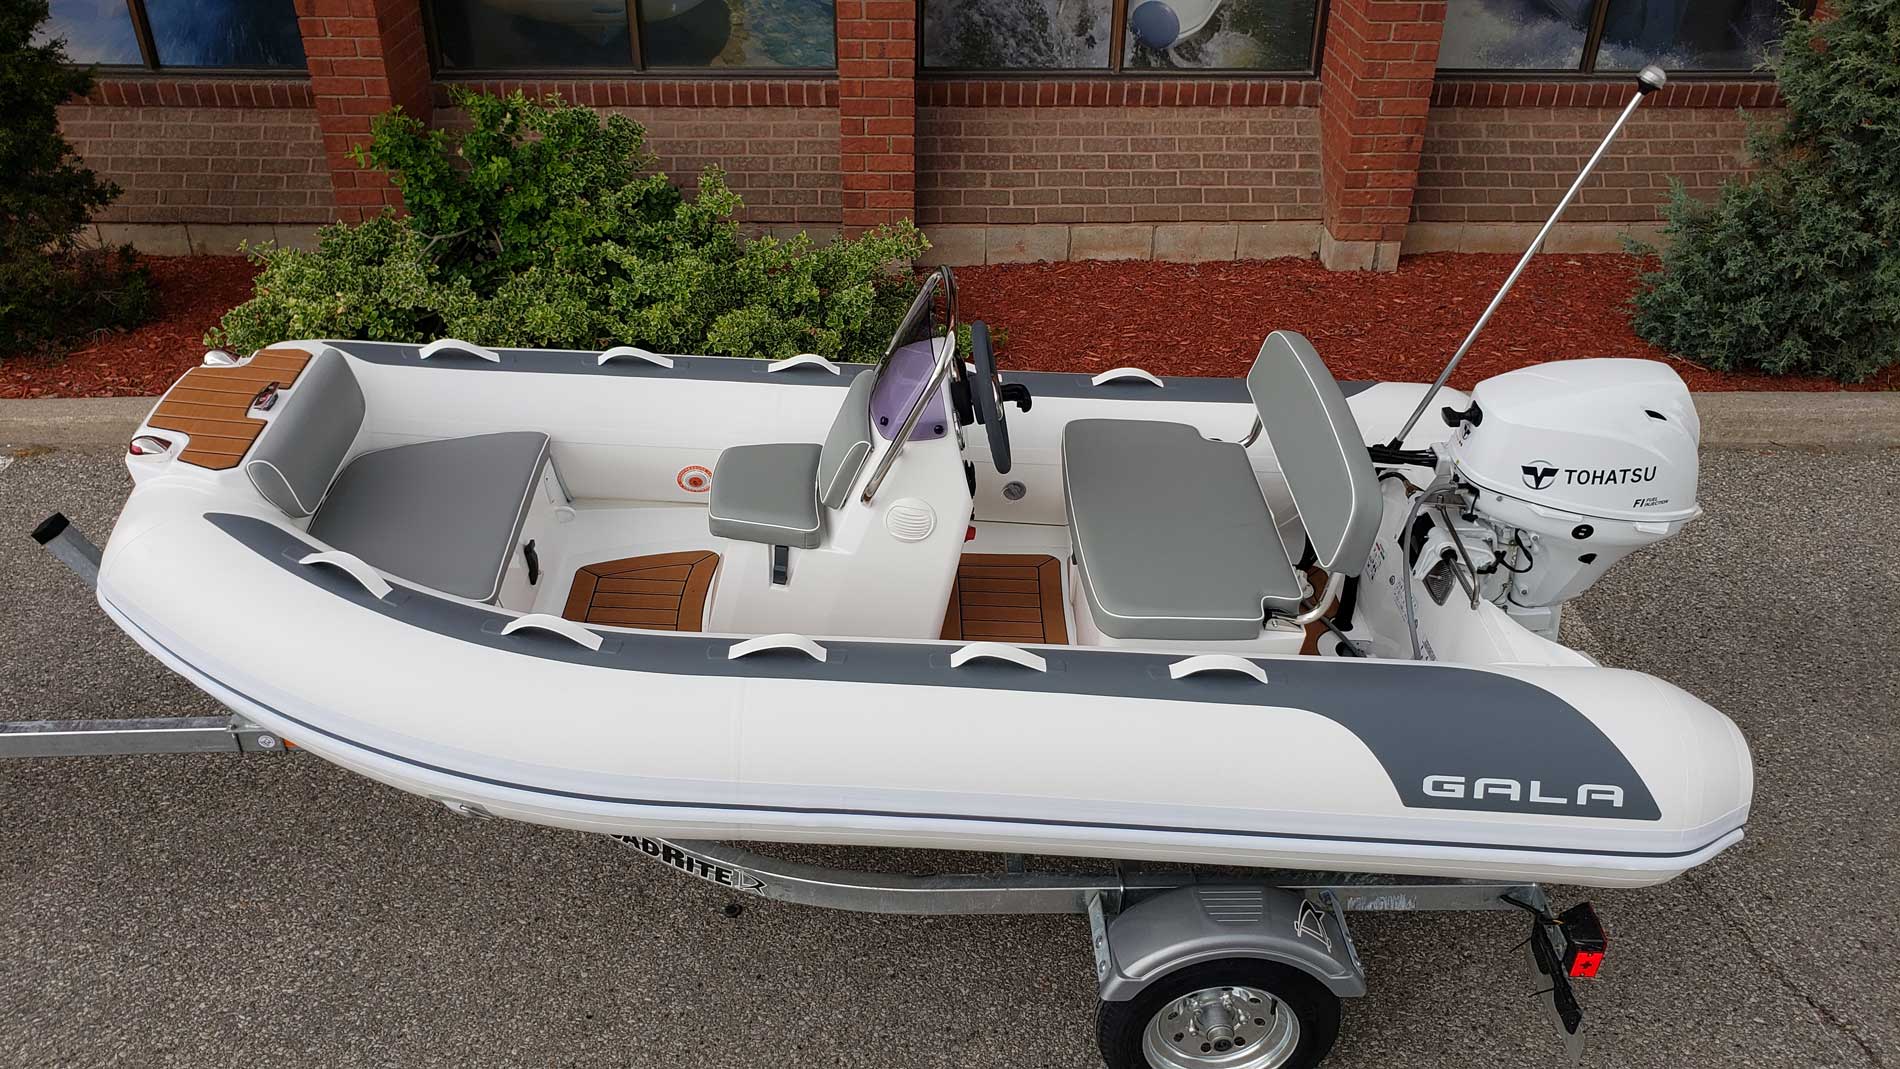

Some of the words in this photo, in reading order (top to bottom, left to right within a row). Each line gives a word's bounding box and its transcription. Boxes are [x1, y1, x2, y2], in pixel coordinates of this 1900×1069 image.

[1565, 466, 1657, 485] TOHATSU
[1633, 499, 1645, 508] FI
[1422, 775, 1624, 807] GALA
[609, 834, 733, 886] ADRITE
